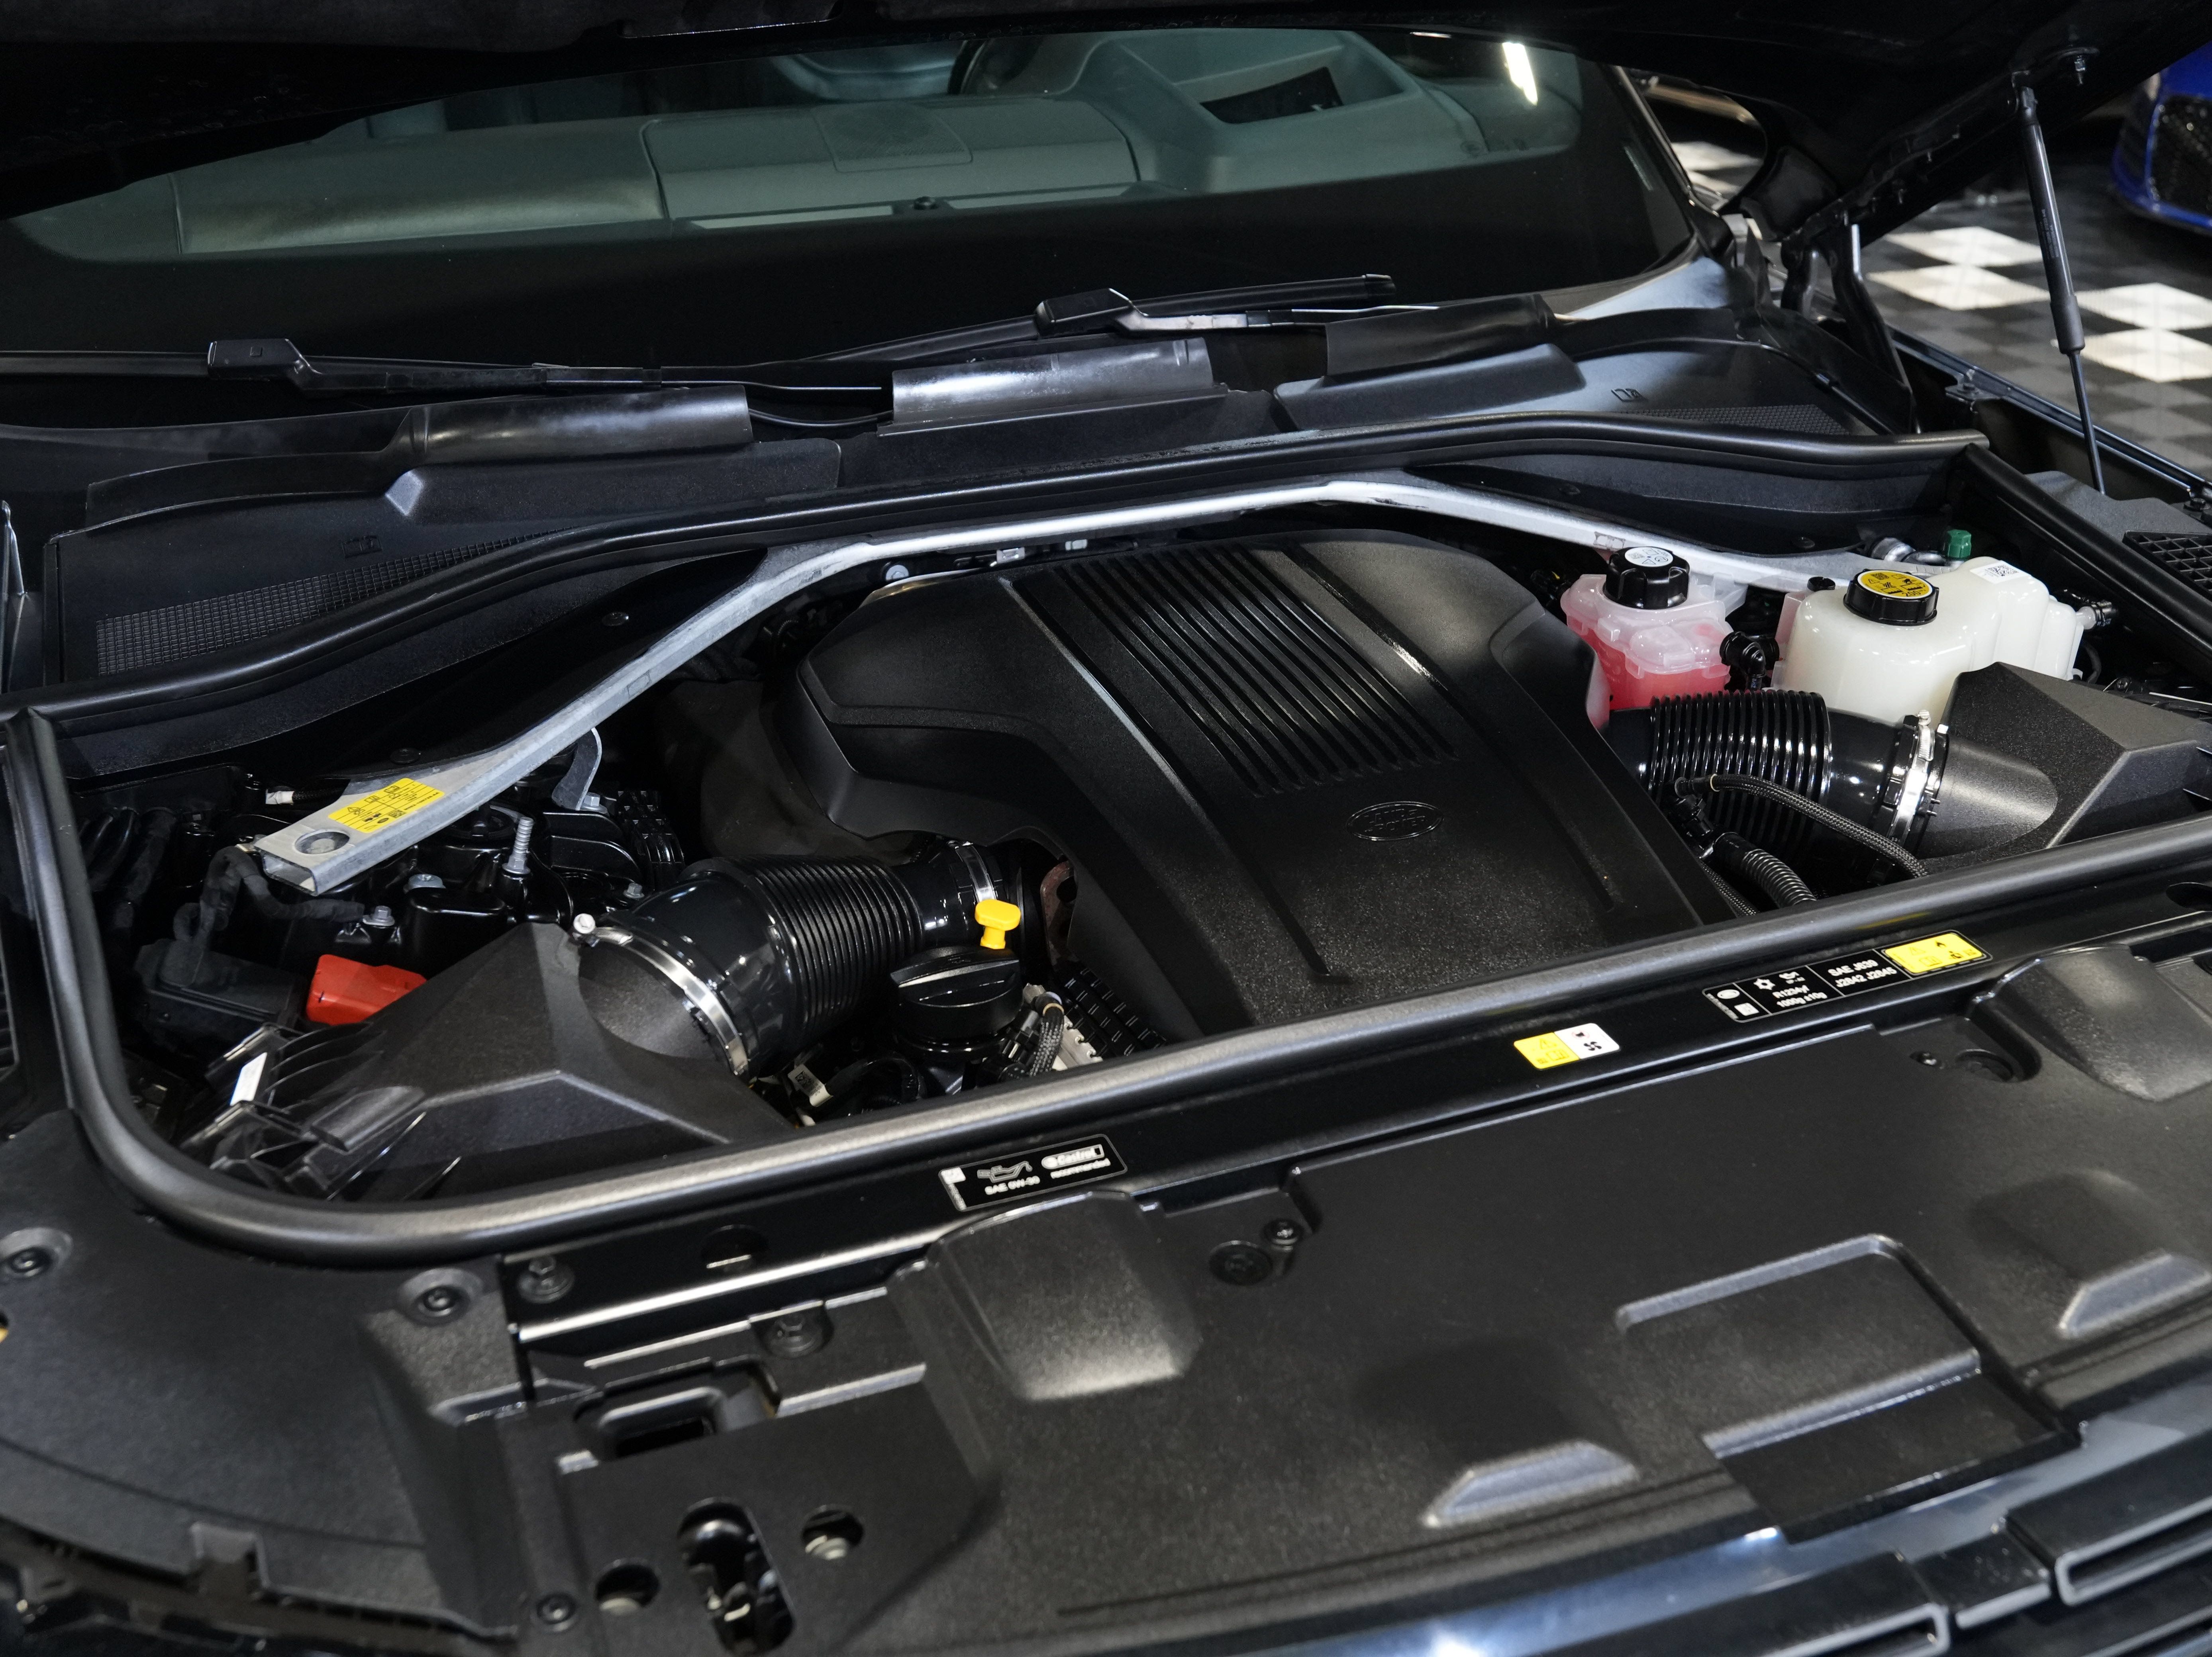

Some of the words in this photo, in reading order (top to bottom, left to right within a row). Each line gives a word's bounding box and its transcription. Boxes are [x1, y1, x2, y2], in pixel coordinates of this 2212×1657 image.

[1828, 966, 1854, 976] SAE
[1853, 960, 1878, 970] J639
[1835, 975, 1867, 987] J2842
[1866, 967, 1897, 979] J2845
[1773, 985, 1809, 998] R1234yf
[1777, 997, 1806, 1007] 1000g
[1057, 1147, 1096, 1165] Castrol
[1051, 1158, 1110, 1179] recommended
[985, 1183, 1008, 1195] SAE
